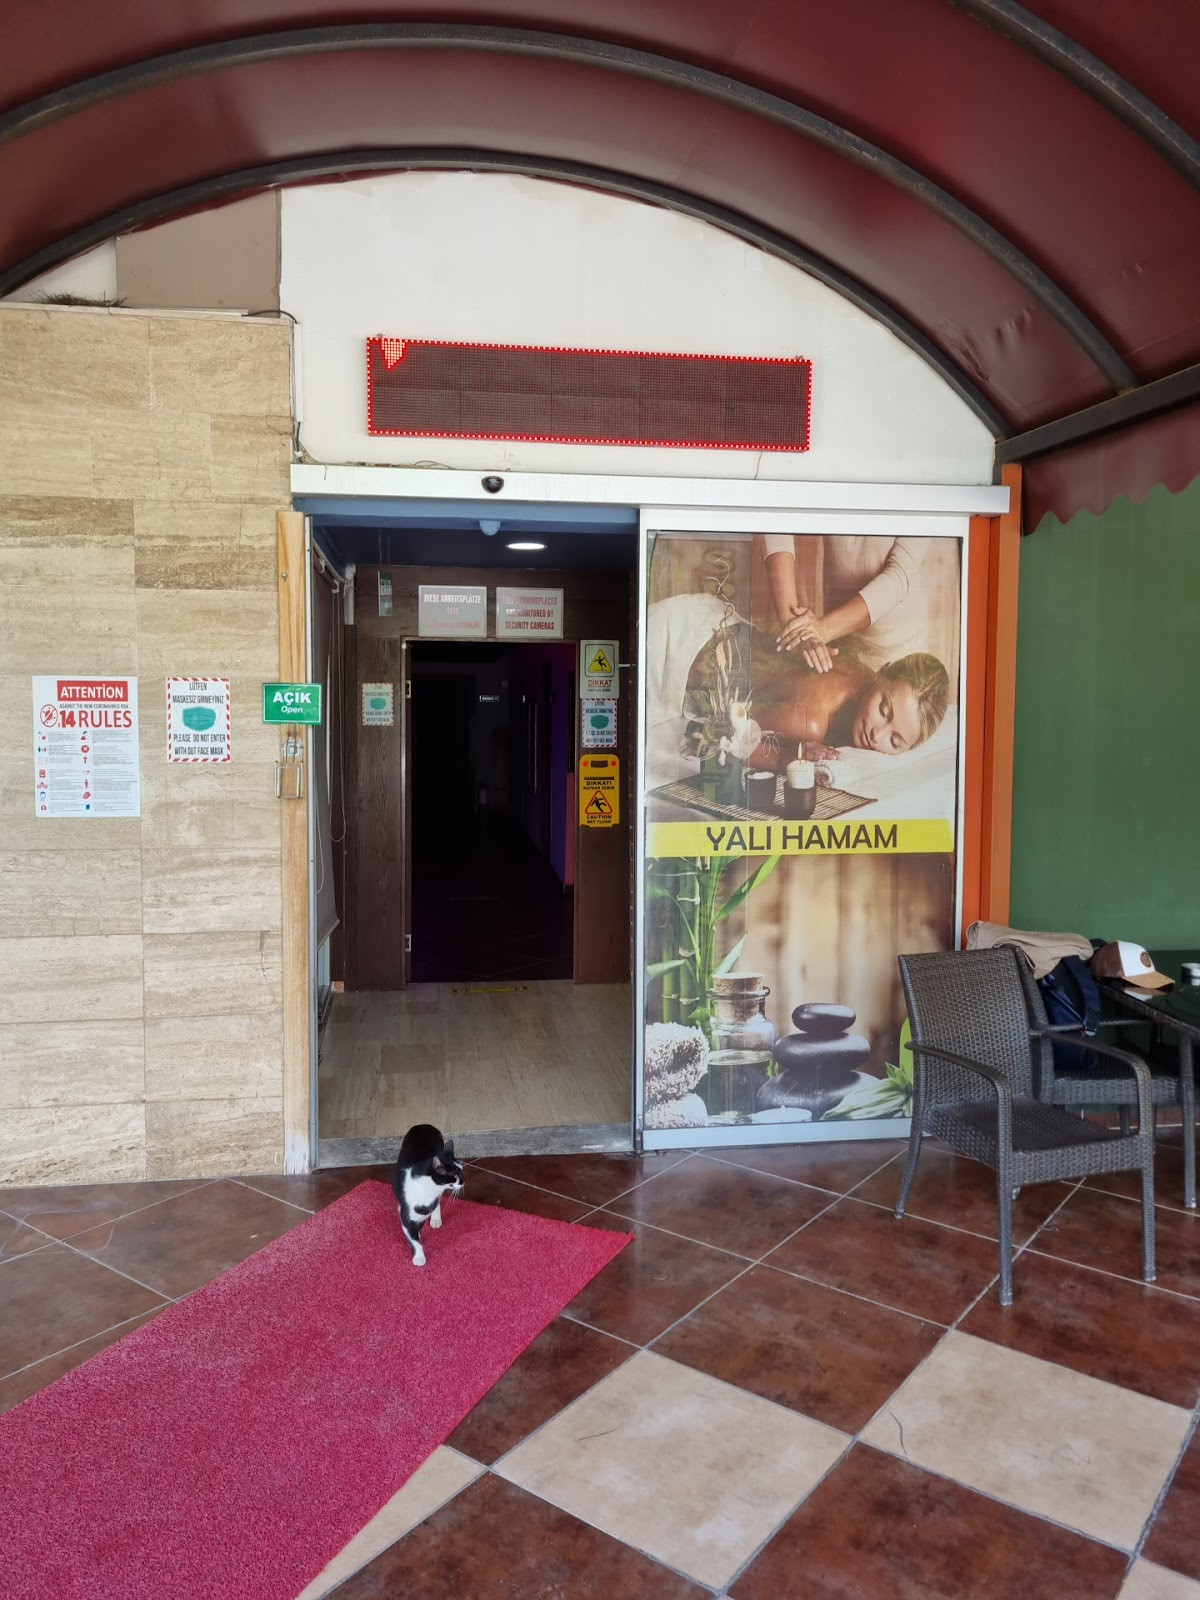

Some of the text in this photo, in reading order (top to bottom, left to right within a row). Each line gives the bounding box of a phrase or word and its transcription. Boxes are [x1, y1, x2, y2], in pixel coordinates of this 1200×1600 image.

[423, 594, 440, 603] DIESE
[515, 596, 558, 606] ORKINGPLACES
[505, 621, 554, 630] SECURITY CAMERAS
[588, 679, 612, 687] DİKKAT
[272, 691, 312, 706] AÇIK
[281, 706, 304, 715] Open
[60, 709, 133, 729] 14 RULES
[173, 733, 226, 742] PLEASE DO NOT ENTER
[174, 747, 224, 755] WITH OUT FACE MASK
[706, 824, 898, 851] YALI HAMAM
